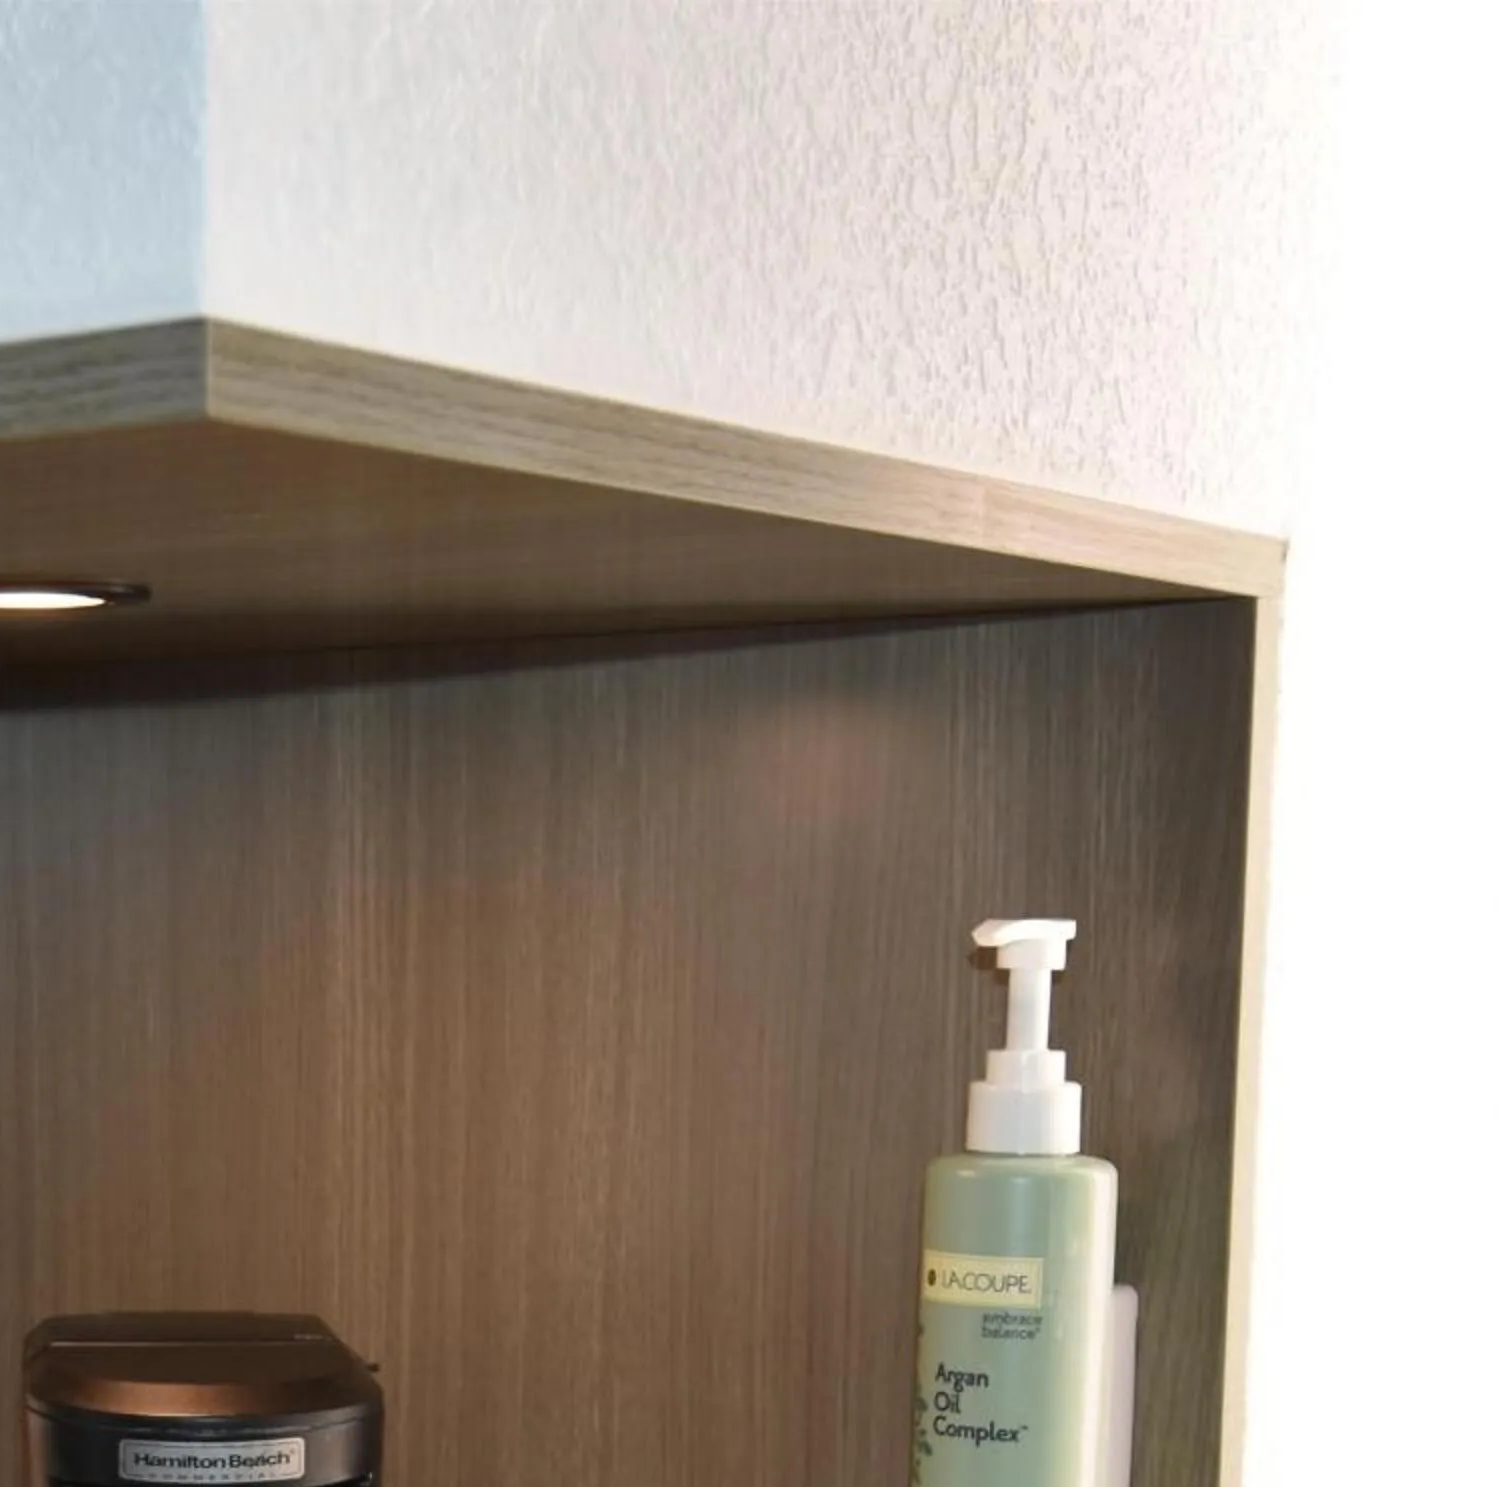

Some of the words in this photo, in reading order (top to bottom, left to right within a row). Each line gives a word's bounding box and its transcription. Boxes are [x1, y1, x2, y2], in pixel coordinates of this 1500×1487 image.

[935, 1362, 989, 1393] Argan
[934, 1392, 961, 1414] Oil
[133, 1452, 225, 1469] Hamilton
[229, 1451, 291, 1468] Beach
